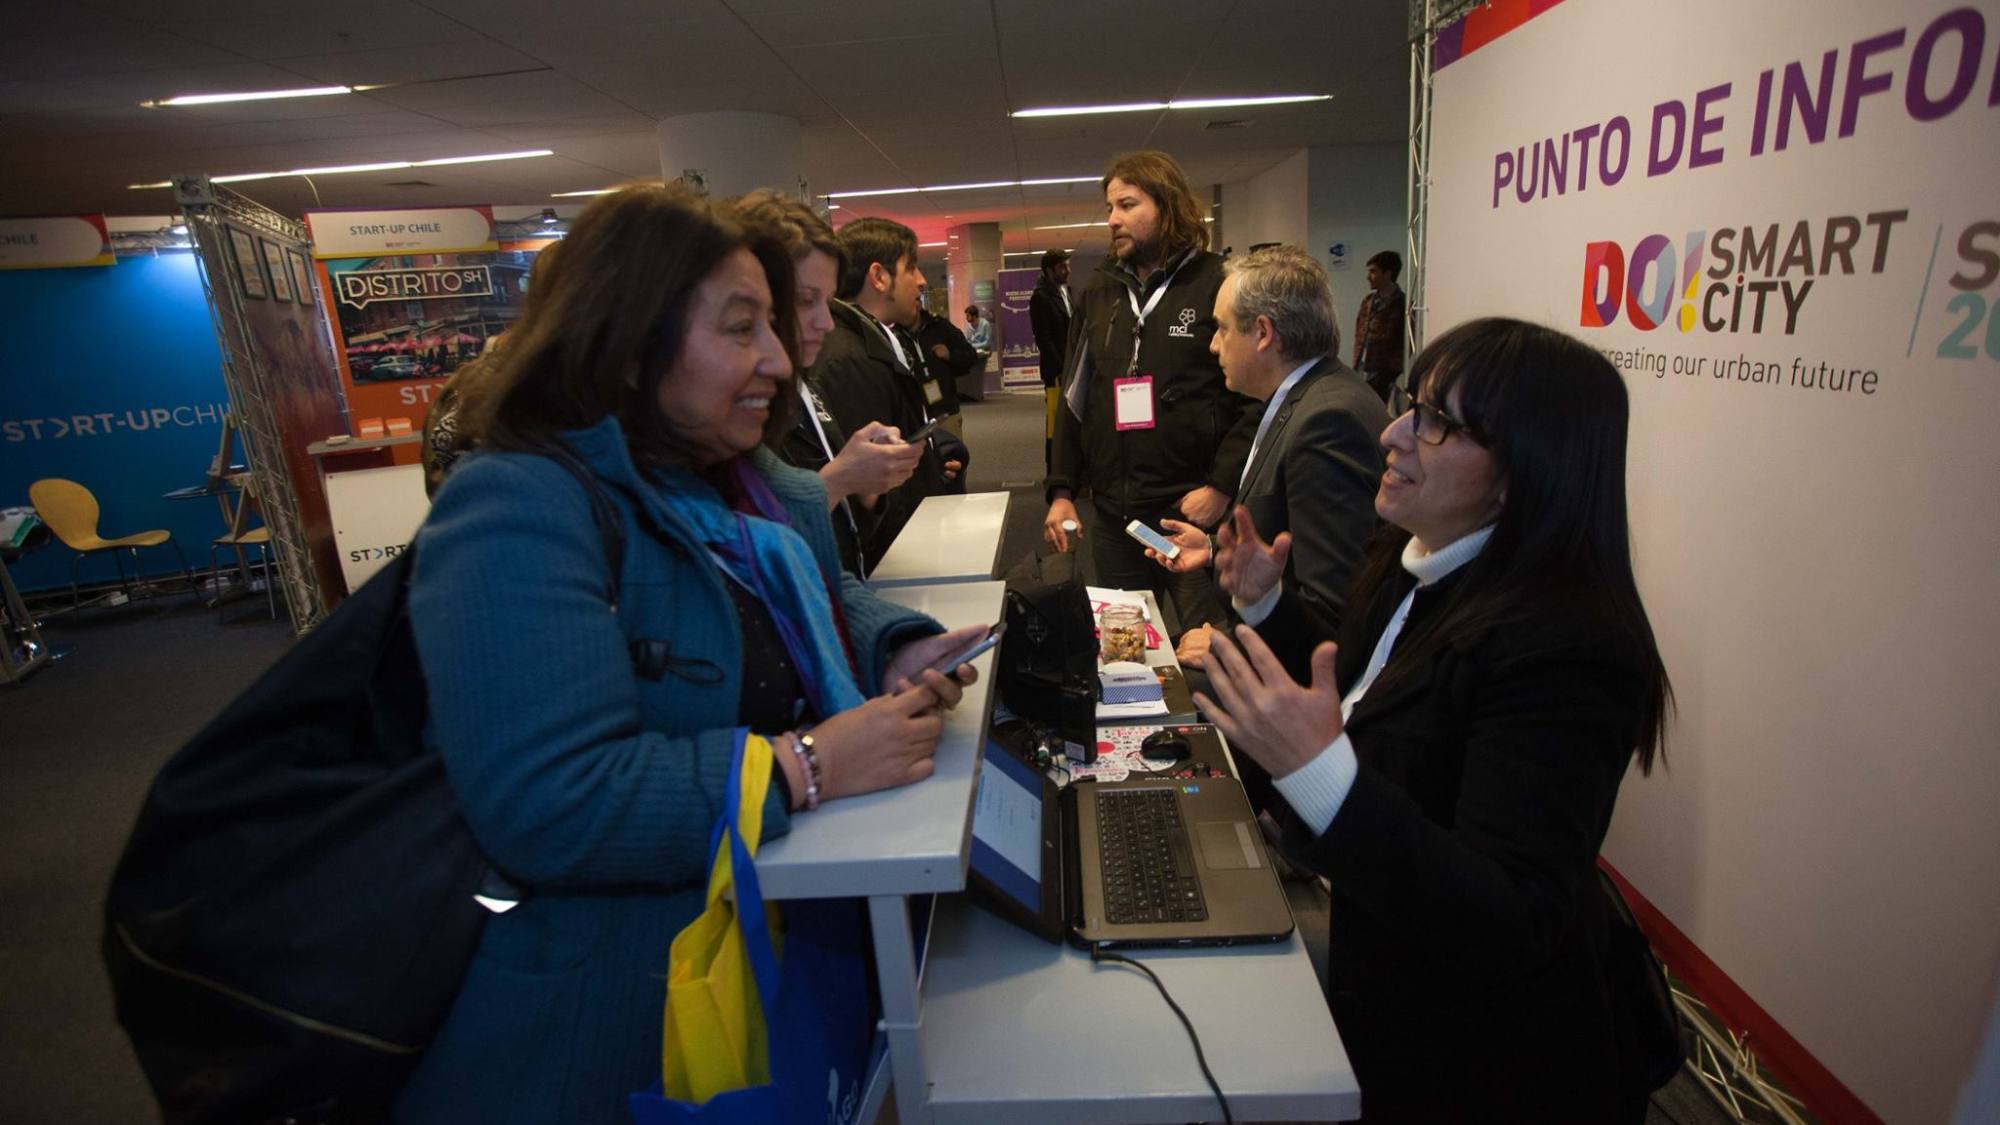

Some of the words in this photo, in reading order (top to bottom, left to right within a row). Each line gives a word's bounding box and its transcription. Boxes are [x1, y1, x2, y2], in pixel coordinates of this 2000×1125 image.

[1492, 115, 1631, 209] PUNTO
[1647, 82, 1732, 178] DE
[1750, 6, 2000, 157] INFO
[350, 224, 406, 236] START-UP
[408, 222, 441, 234] CHILE
[345, 271, 463, 298] DISTRITO
[463, 270, 482, 284] SH
[1580, 230, 1706, 334] DO!
[1707, 209, 1909, 280] SMART
[1673, 354, 1707, 377] our
[1713, 353, 1781, 385] urban
[1790, 356, 1879, 395] future
